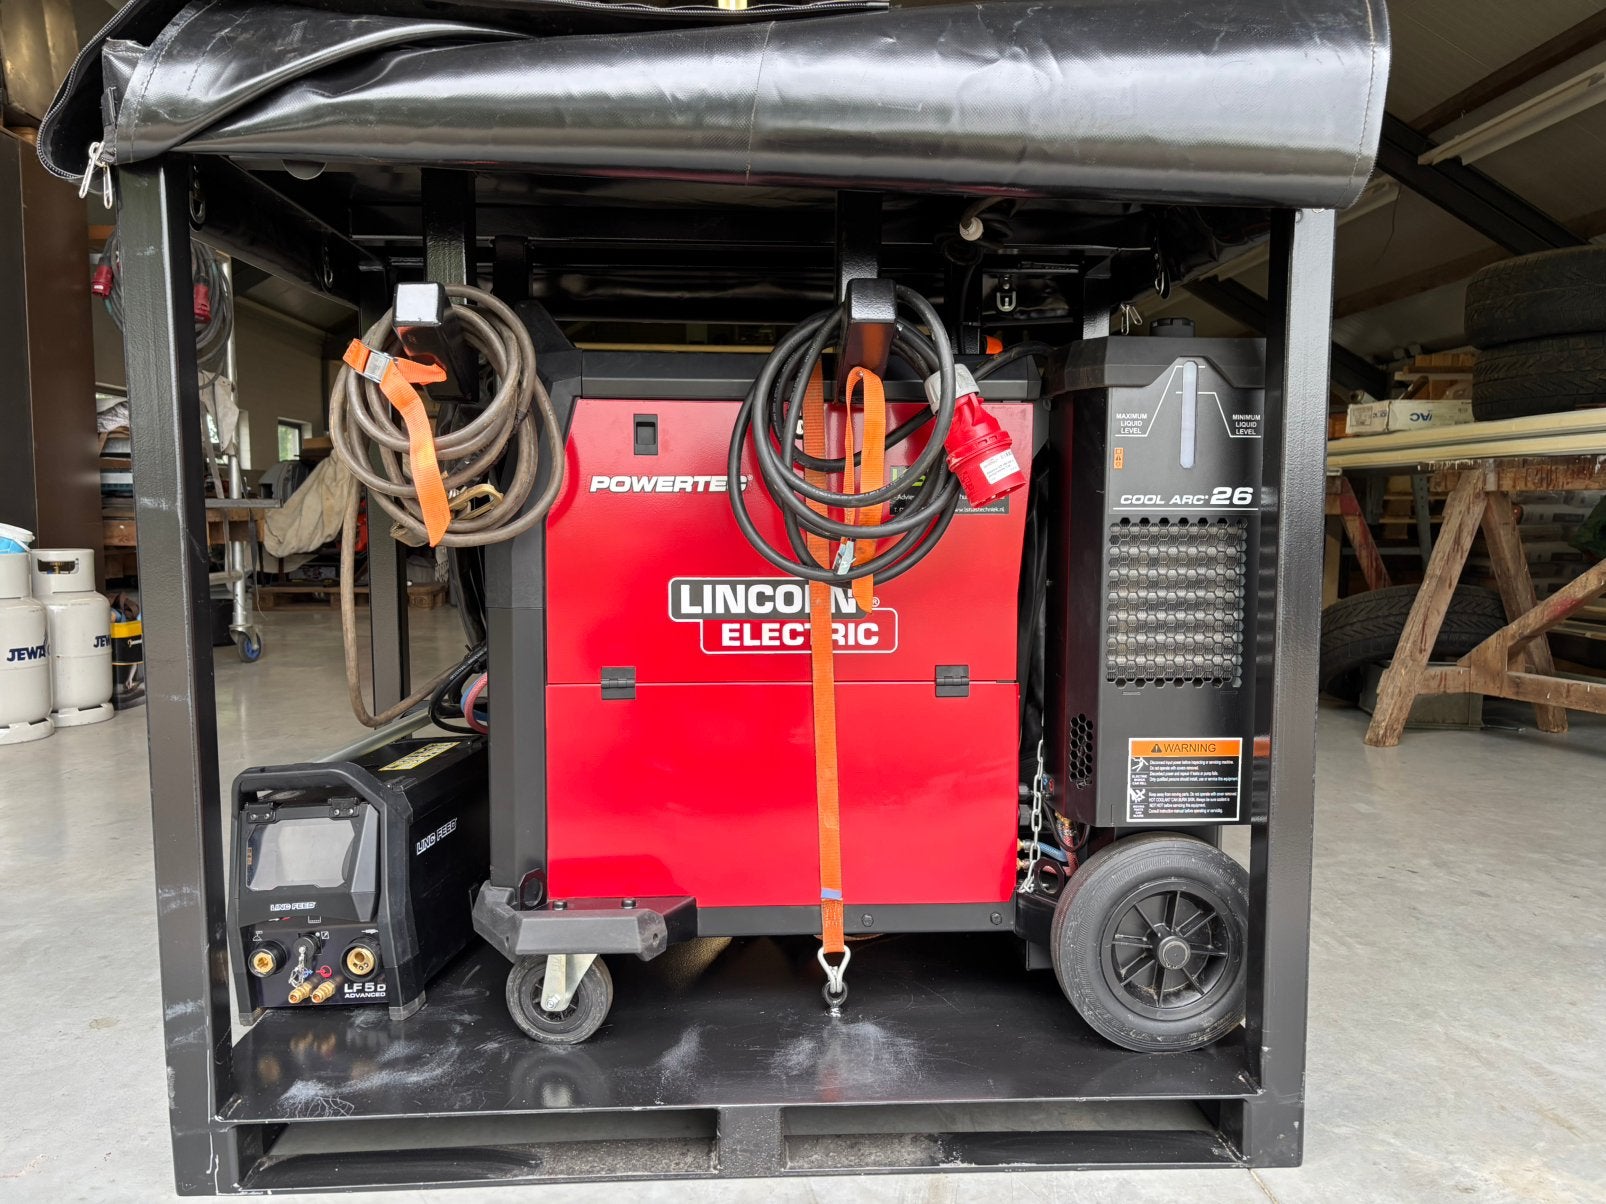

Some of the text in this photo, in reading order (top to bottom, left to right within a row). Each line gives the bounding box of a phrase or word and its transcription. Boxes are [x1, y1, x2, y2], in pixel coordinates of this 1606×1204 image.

[1120, 487, 1254, 505] COOL ARC 26
[721, 622, 880, 646] ELECRIC
[6, 645, 46, 661] JEWA
[1164, 743, 1216, 753] WARNING
[416, 818, 457, 855] LINC FEED
[270, 902, 316, 911] LINC FEED
[344, 983, 363, 993] LF
